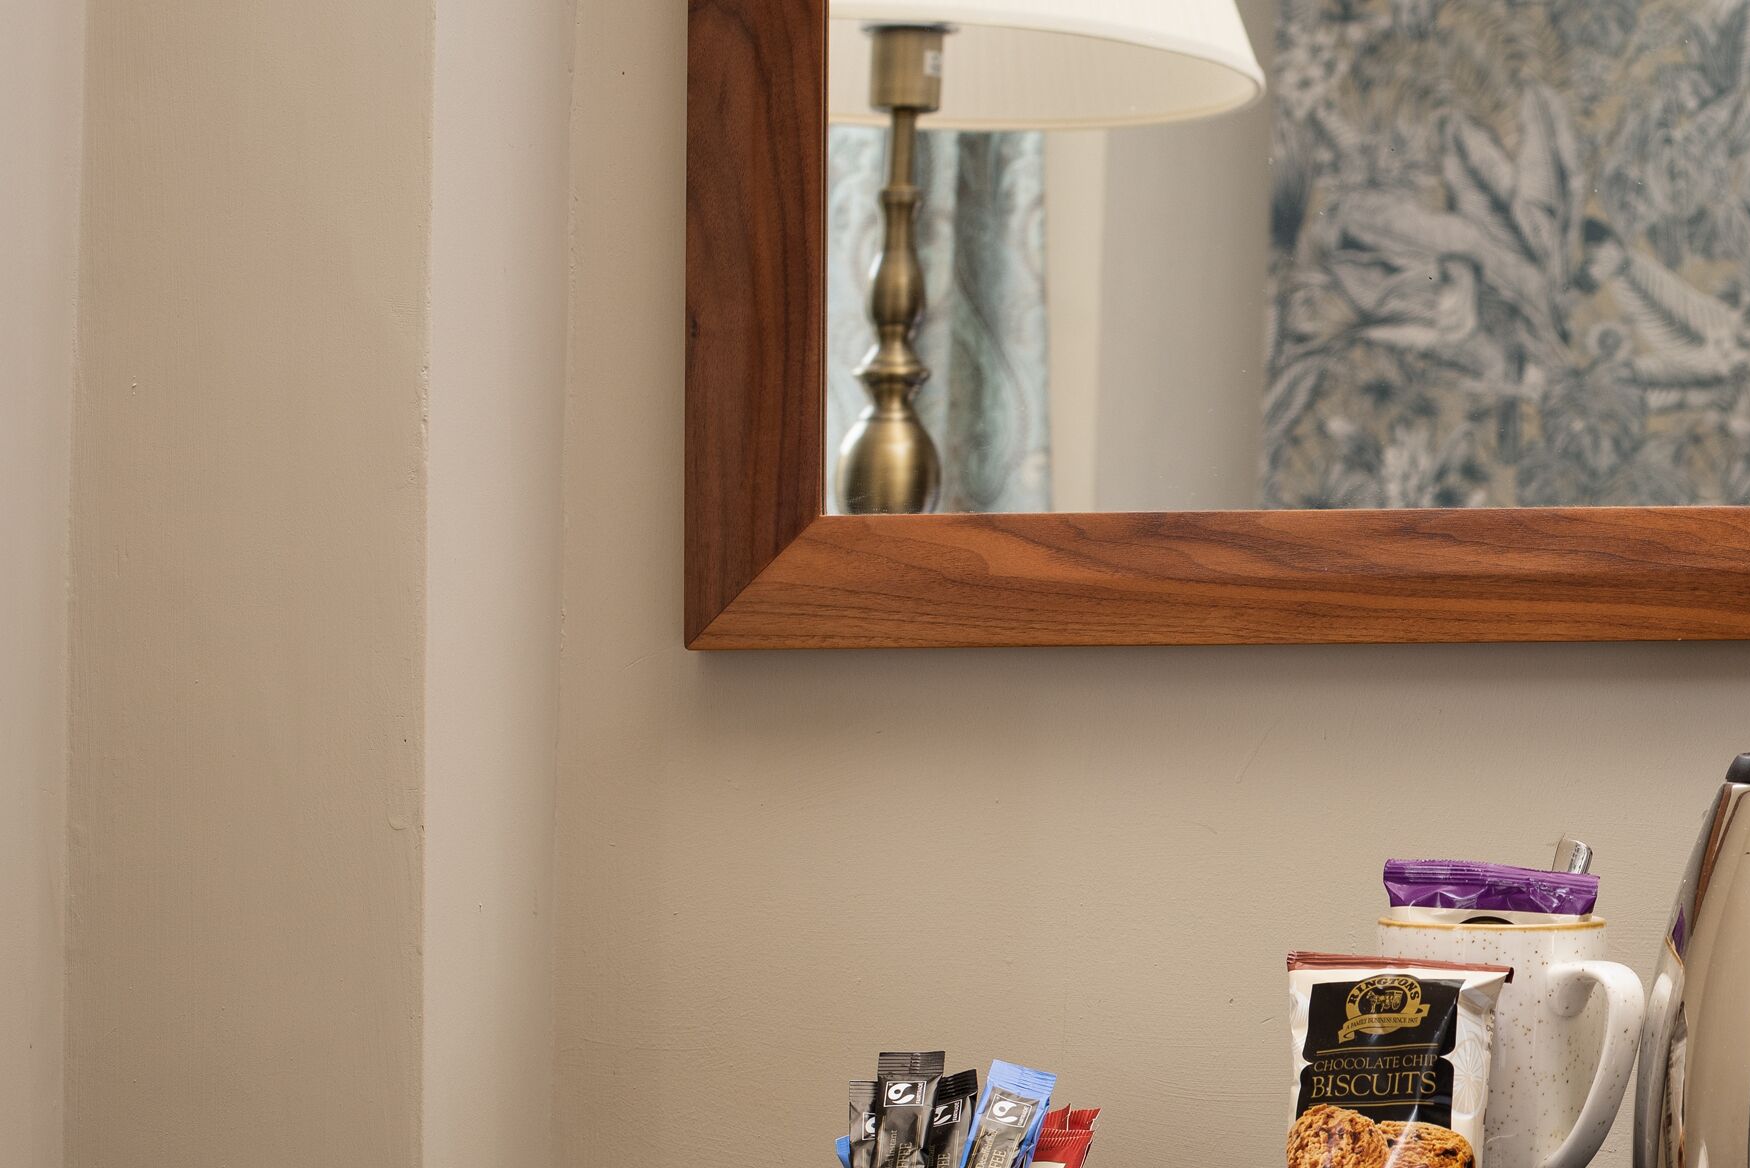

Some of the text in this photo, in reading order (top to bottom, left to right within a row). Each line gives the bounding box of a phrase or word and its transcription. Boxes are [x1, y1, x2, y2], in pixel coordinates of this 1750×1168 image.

[1347, 977, 1420, 1005] RINGTONS
[1313, 1054, 1439, 1073] CHOCOLATE CHIP
[1311, 1071, 1437, 1099] BISCUITS
